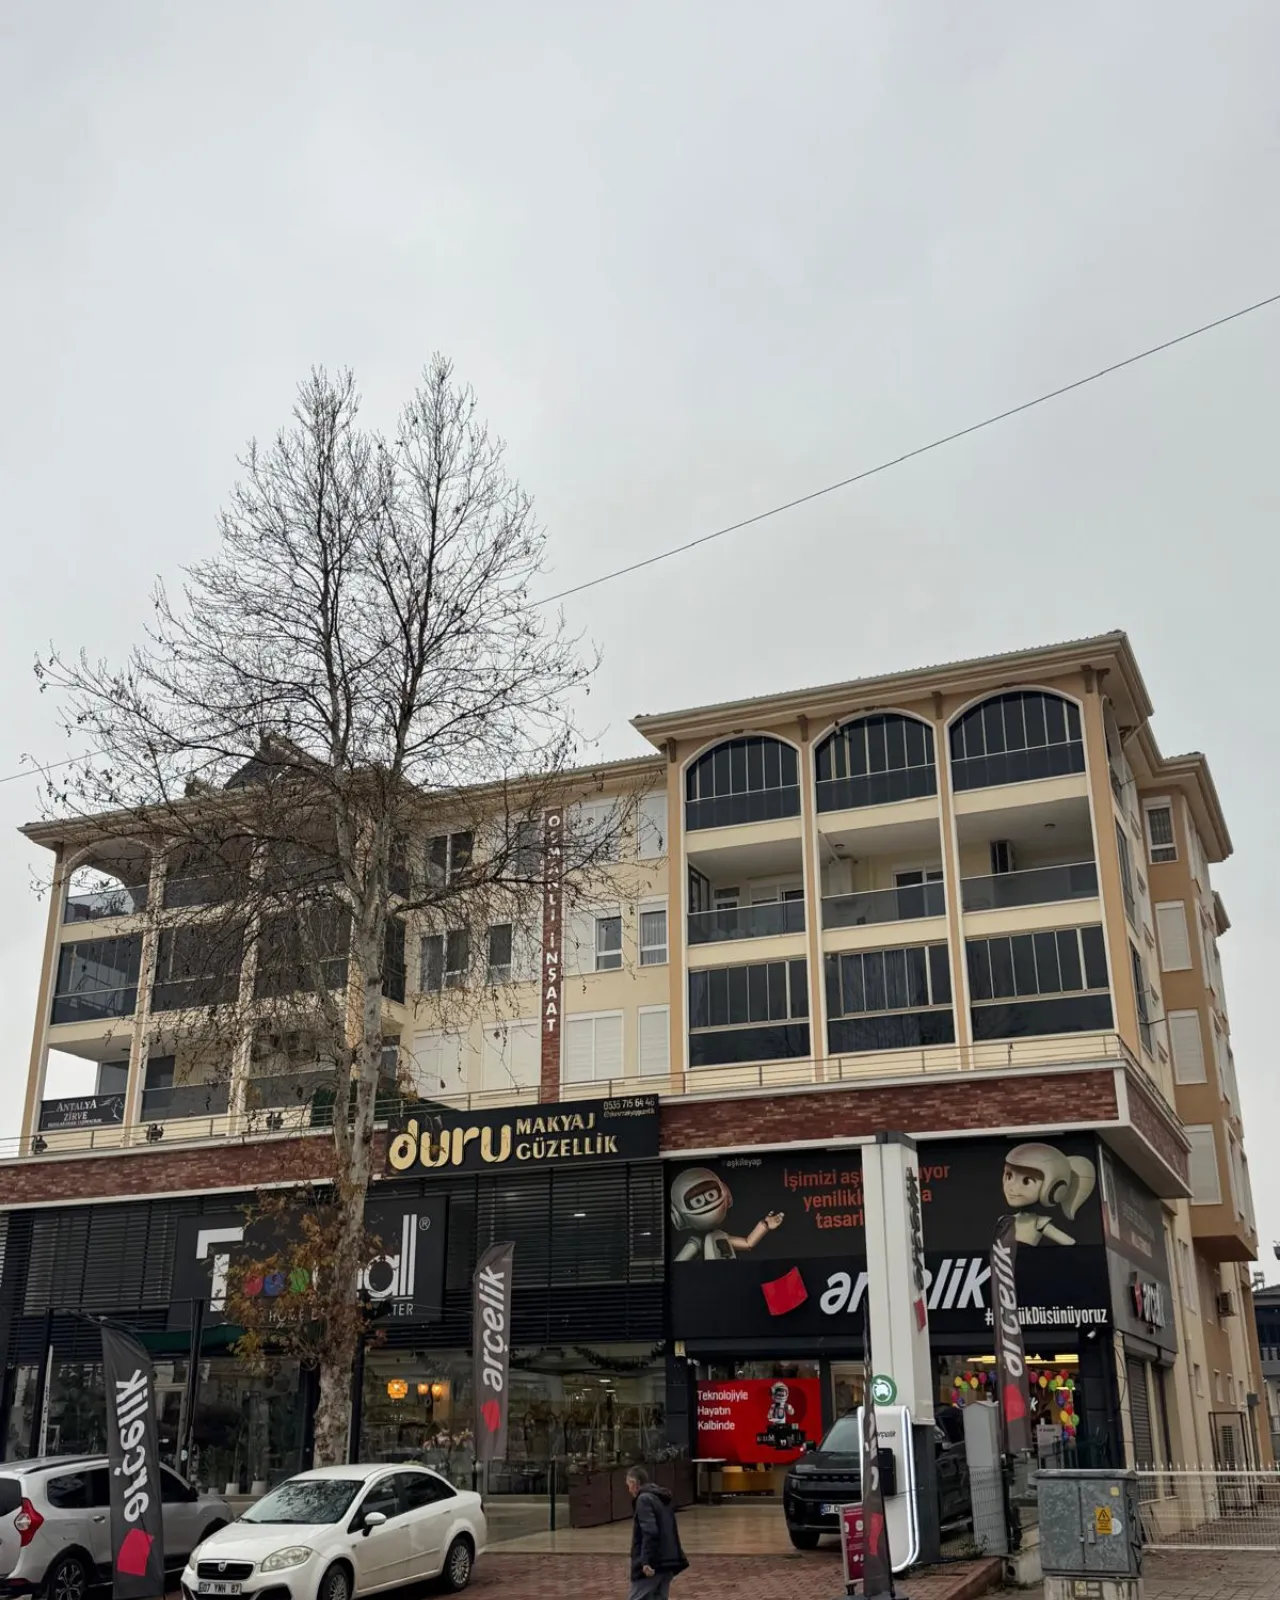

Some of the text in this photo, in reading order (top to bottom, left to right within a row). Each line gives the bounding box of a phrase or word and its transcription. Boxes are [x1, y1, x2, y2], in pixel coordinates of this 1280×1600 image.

[56, 1099, 97, 1112] ANTALYA
[64, 1111, 88, 1121] ZİRVE
[516, 1112, 596, 1135] MAKYAJ
[389, 1118, 512, 1171] duru
[516, 1132, 618, 1160] GÜZELLİK
[784, 1168, 836, 1192] İşimizi
[816, 1211, 865, 1229] tasarl
[820, 1258, 992, 1315] arlik
[479, 1265, 508, 1392] arçelik
[697, 1389, 749, 1402] Teknolojiyle
[697, 1406, 731, 1418] Hayatın
[697, 1420, 735, 1431] Kalbinde
